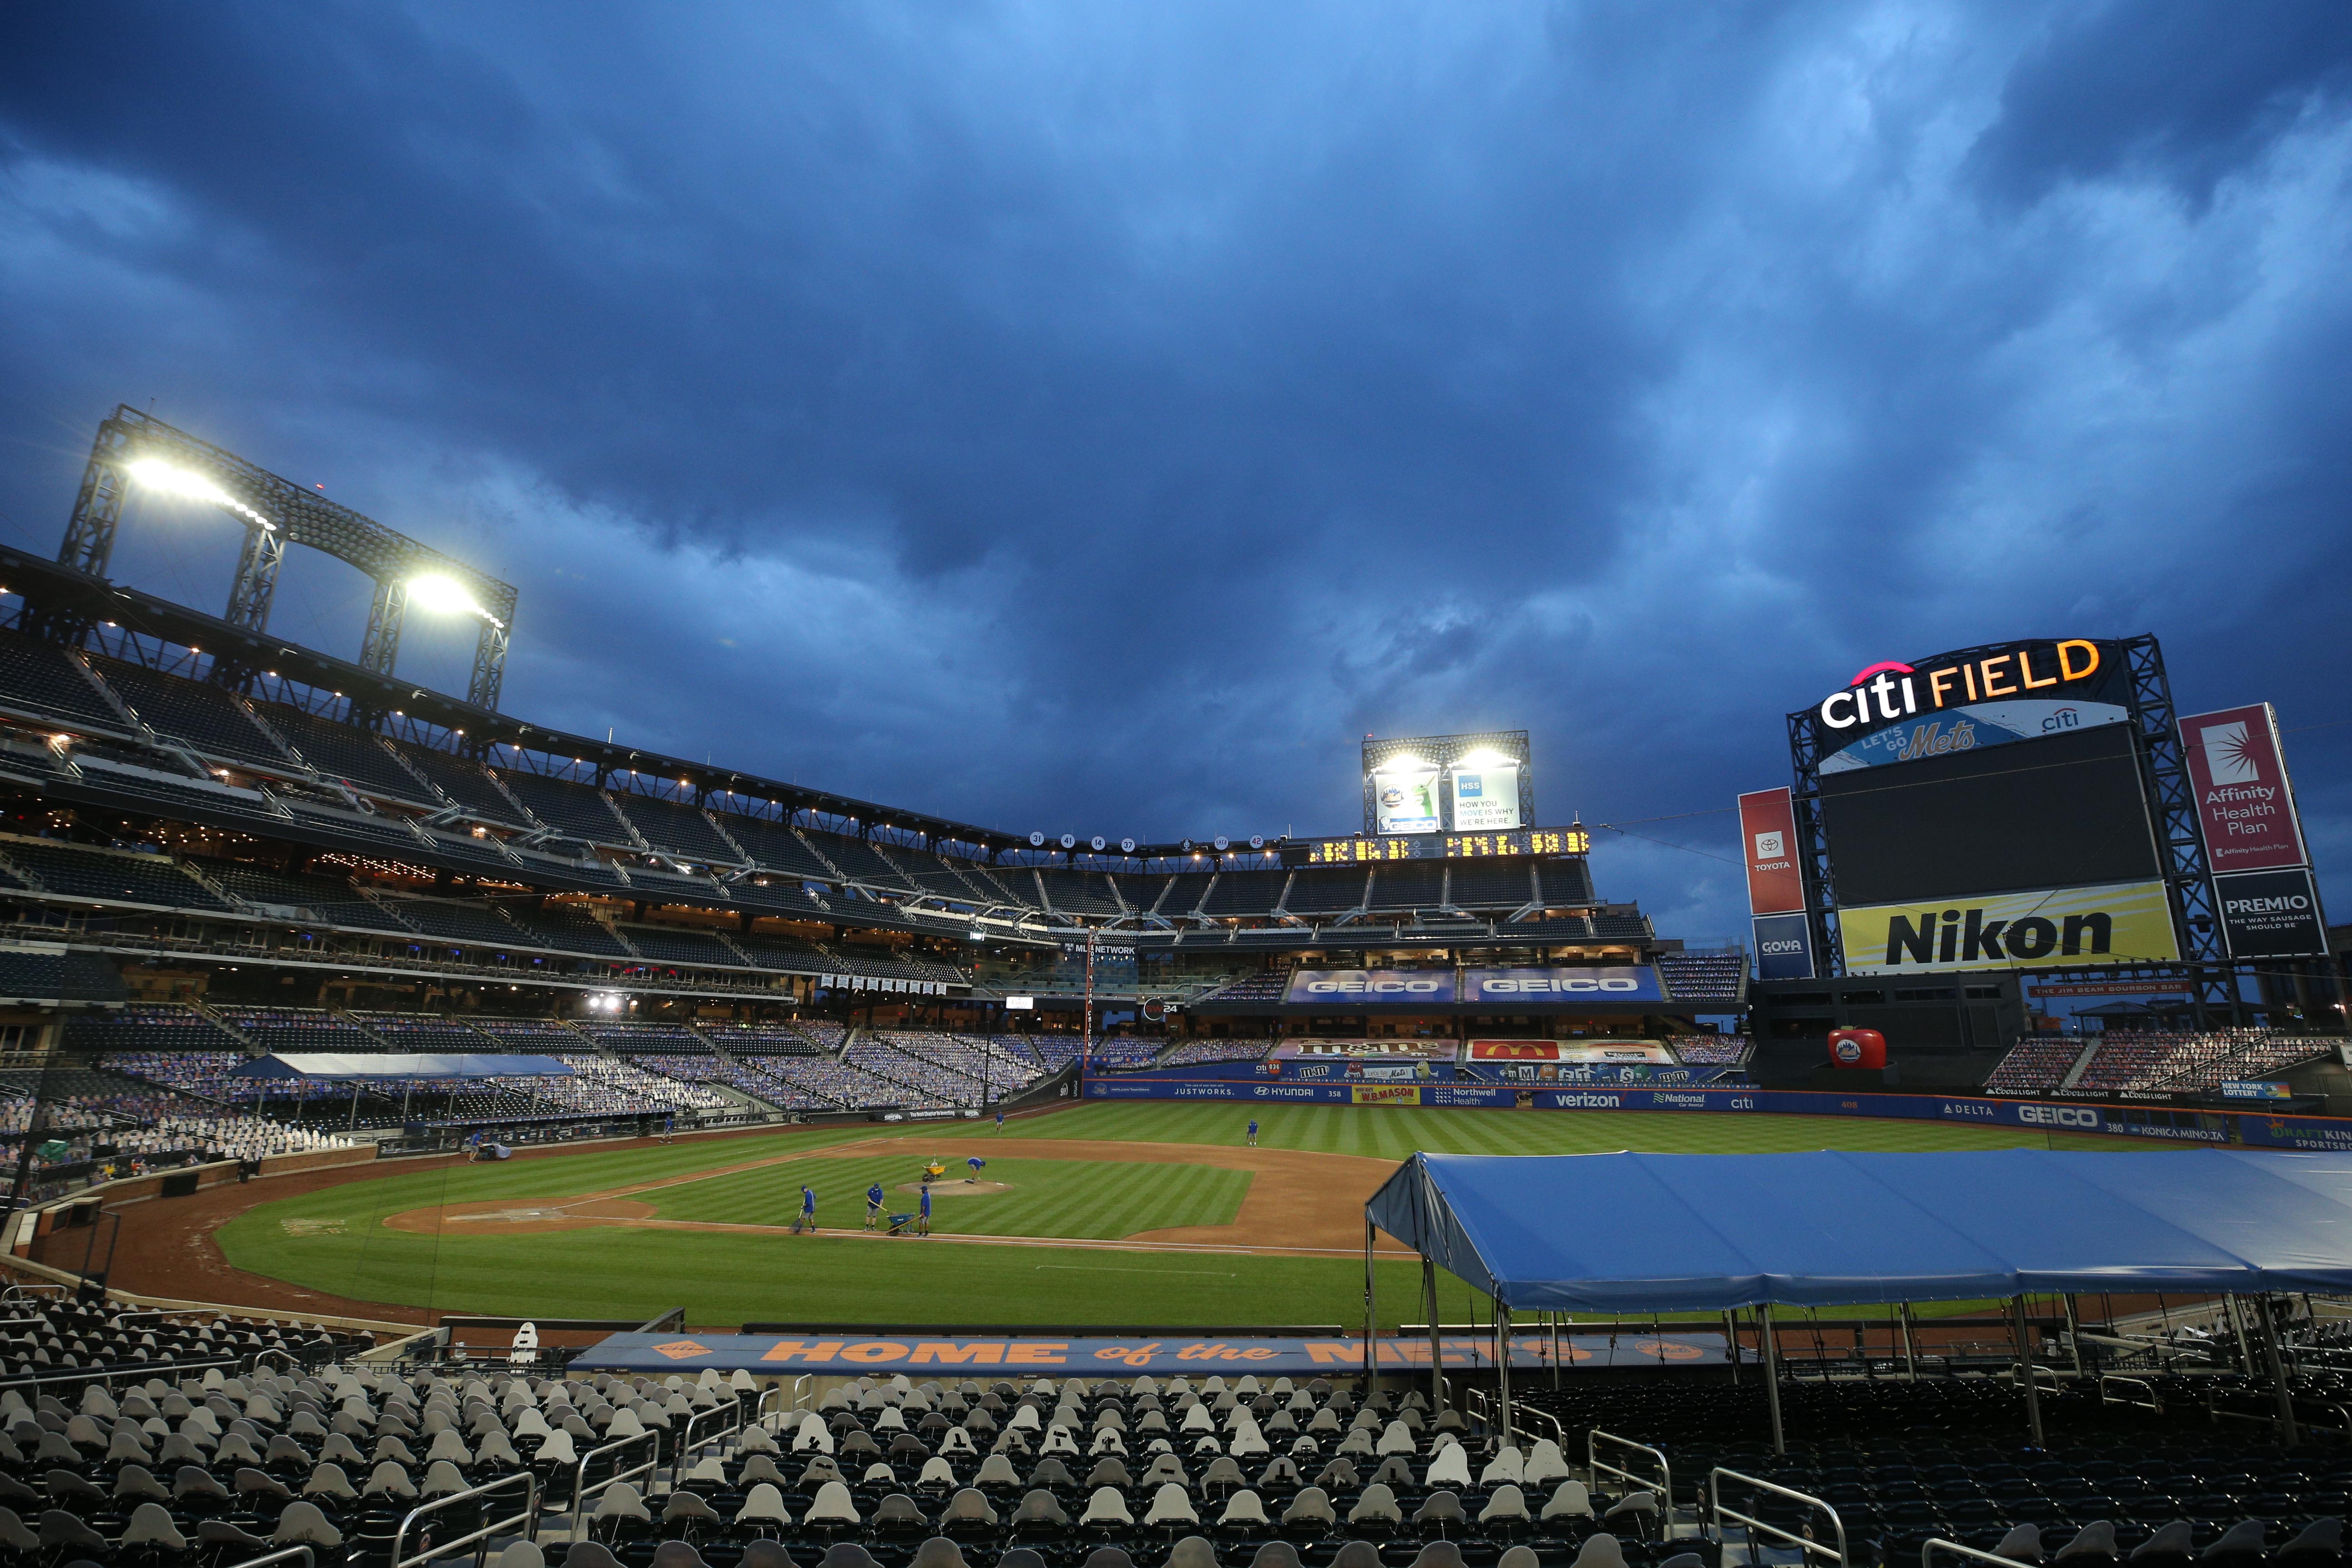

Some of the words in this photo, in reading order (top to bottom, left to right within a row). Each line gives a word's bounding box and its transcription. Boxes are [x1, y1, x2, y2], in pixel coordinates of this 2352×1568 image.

[1821, 673, 1916, 728] citi
[1929, 639, 2099, 707] FIELD
[2042, 712, 2078, 730] citi
[1861, 726, 1903, 750] LET'S
[1886, 736, 1907, 751] GO
[1898, 720, 1975, 761] Mets
[2206, 786, 2275, 804] Affinity
[2213, 802, 2275, 821] Health
[1390, 820, 1436, 831] GEICO
[2227, 822, 2268, 836] Plan
[1755, 862, 1790, 872] TOYOTA
[2225, 895, 2308, 914] PREMIO
[1886, 909, 2112, 965] Nikon
[1095, 946, 1135, 954] NETWORK
[1762, 940, 1801, 953] GOYA
[1307, 980, 1438, 993] GEICO
[1483, 977, 1638, 993] GEICO
[1272, 1088, 1313, 1096] HYUNDAI
[1453, 1088, 1496, 1097] Northwell
[1665, 1094, 1704, 1102] National
[1995, 1087, 2019, 1096] Coors
[2060, 1088, 2086, 1098] Coors
[2128, 1090, 2150, 1099] Coors
[1453, 1097, 1481, 1105] Health
[1556, 1092, 1620, 1107] verizon
[1731, 1097, 1753, 1108] citi
[1956, 1105, 1994, 1116] DELTA
[2018, 1106, 2098, 1127] GEICO
[2107, 1123, 2123, 1132] 380
[2141, 1126, 2179, 1137] KONICA
[2180, 1129, 2225, 1141] MINOLTA
[760, 1342, 1068, 1363] HOME
[1094, 1343, 1164, 1366] of
[1176, 1343, 1282, 1360] the
[1304, 1341, 1592, 1362] METS
